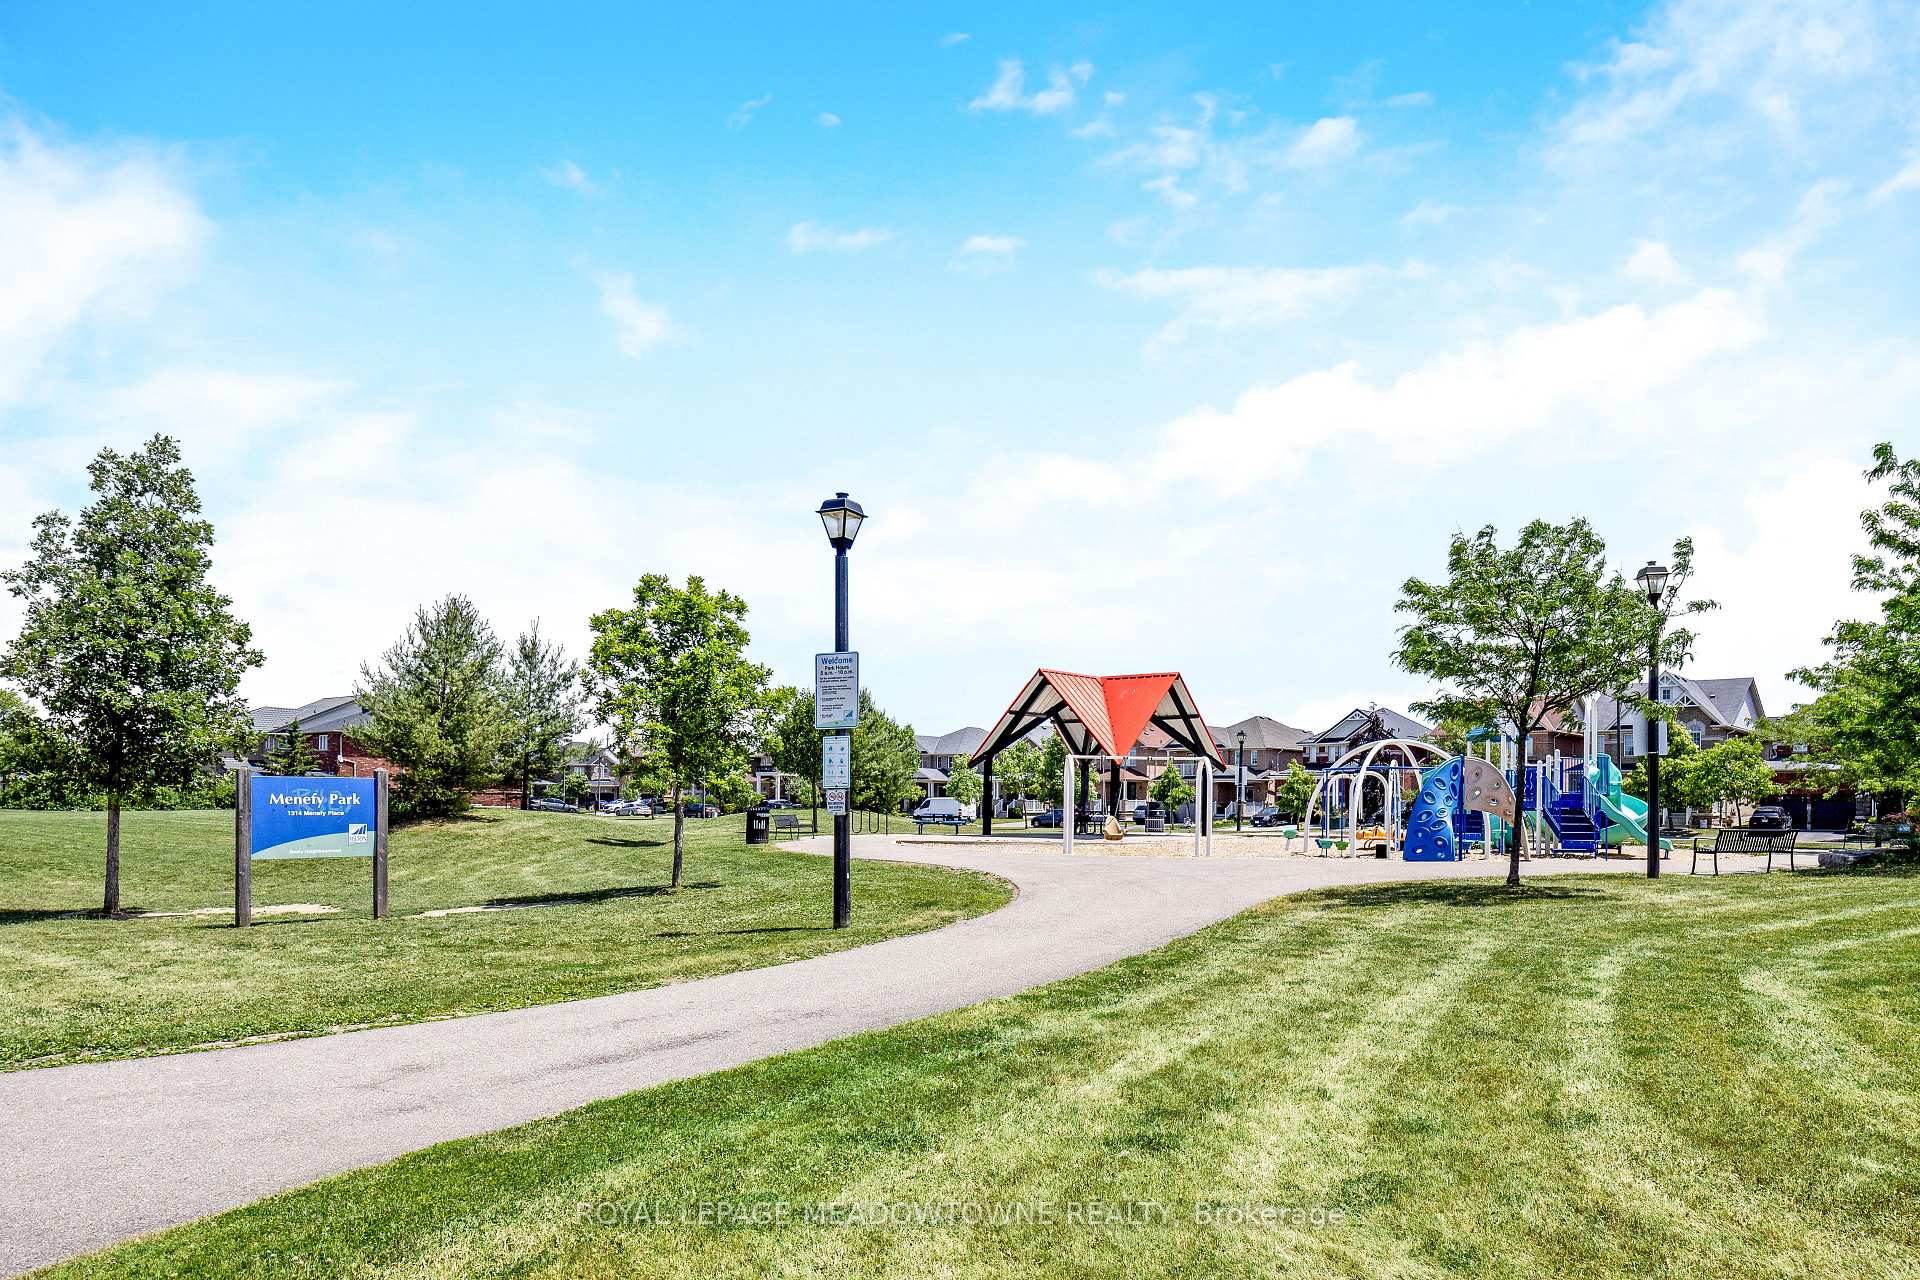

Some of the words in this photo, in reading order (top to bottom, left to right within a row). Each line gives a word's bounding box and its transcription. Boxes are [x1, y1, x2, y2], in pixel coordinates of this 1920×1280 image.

[821, 657, 853, 665] Welcome
[269, 792, 325, 809] Menefy
[330, 792, 361, 805] Park
